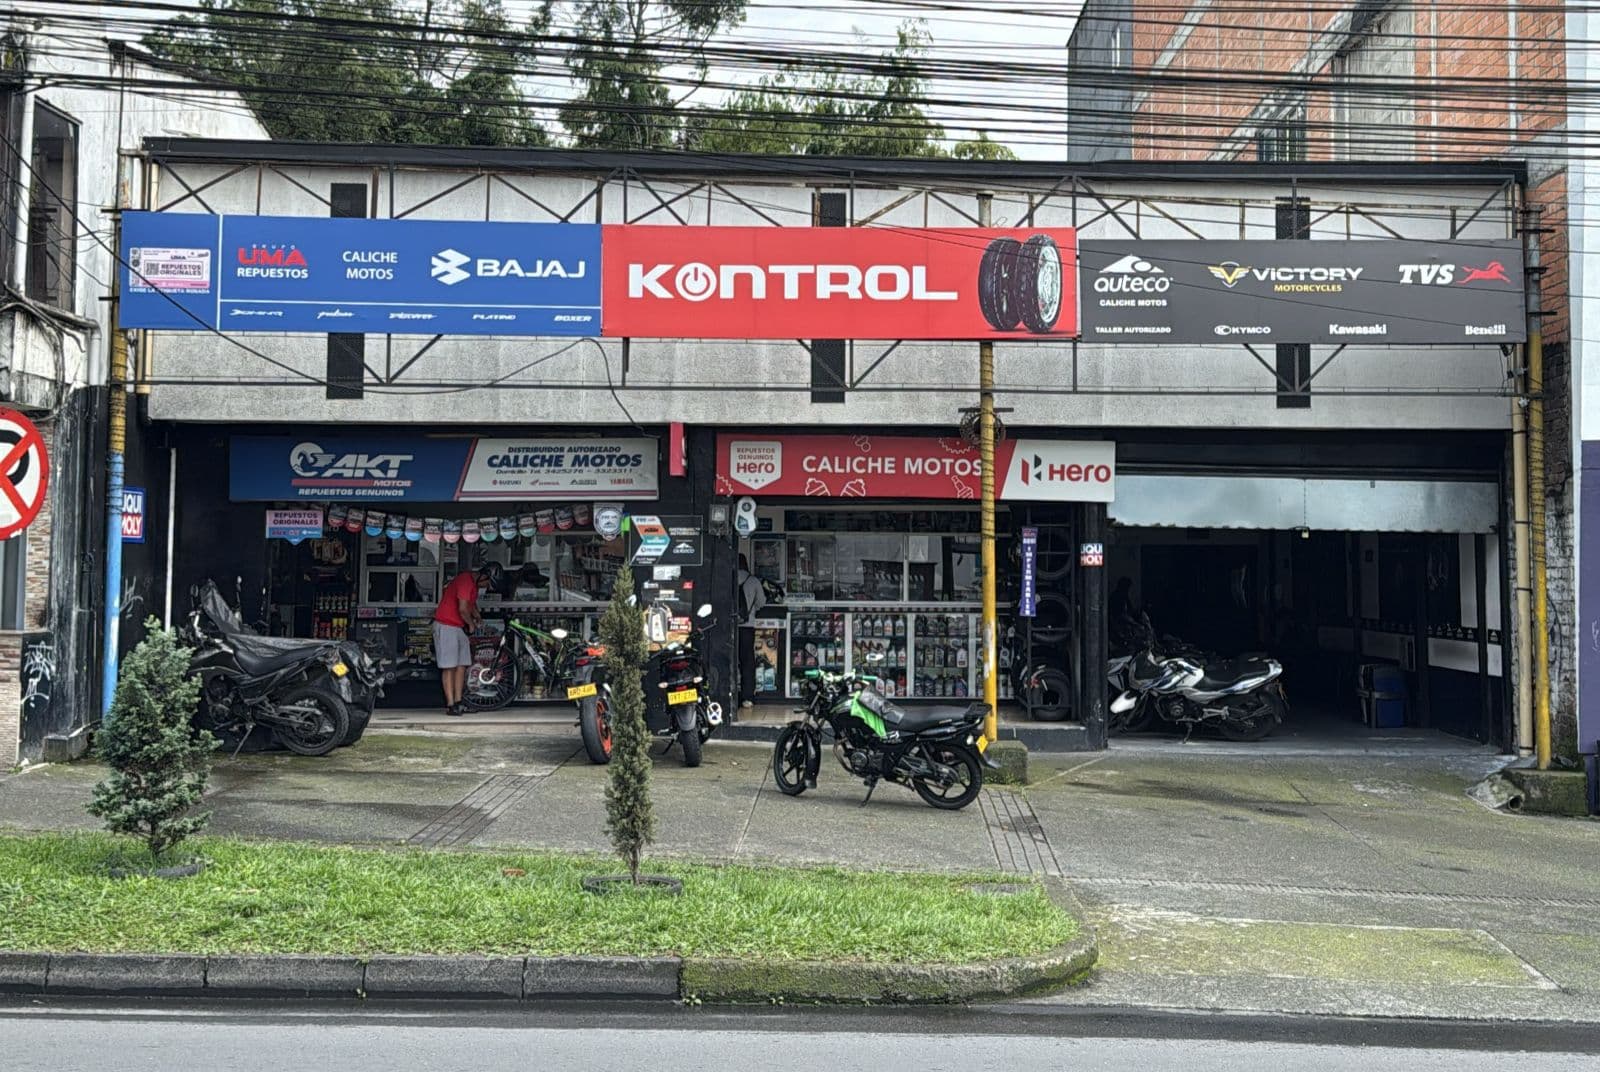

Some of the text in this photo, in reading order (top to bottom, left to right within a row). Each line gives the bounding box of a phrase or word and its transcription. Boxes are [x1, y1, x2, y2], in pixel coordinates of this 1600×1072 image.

[238, 247, 307, 267] UMA
[342, 250, 398, 263] CALICHE
[237, 267, 309, 279] REPUESTOS
[346, 268, 394, 280] MOTOS
[476, 258, 586, 279] BAJAJ
[1398, 264, 1455, 284] TVS
[628, 262, 958, 301] KONTROL
[1094, 275, 1170, 292] auteco
[1274, 284, 1342, 292] MOTORCYCLES
[1099, 299, 1167, 307] CALICHE MOTOS
[554, 314, 592, 322] BOXER
[1095, 326, 1172, 334] TALLER AUTORIZADO
[1231, 323, 1272, 335] KYMCO
[1328, 323, 1387, 335] Kawasaki
[1464, 324, 1506, 335] Benelli
[507, 446, 565, 454] DISTRIBUIDOR
[321, 454, 414, 478] AKT
[487, 454, 643, 468] CALICHE MOTOS
[802, 455, 981, 476] CALICHE MOTOS
[736, 462, 776, 474] Hero
[1049, 463, 1112, 483] Hero
[298, 488, 405, 497] REPUESTOS GENUINOS
